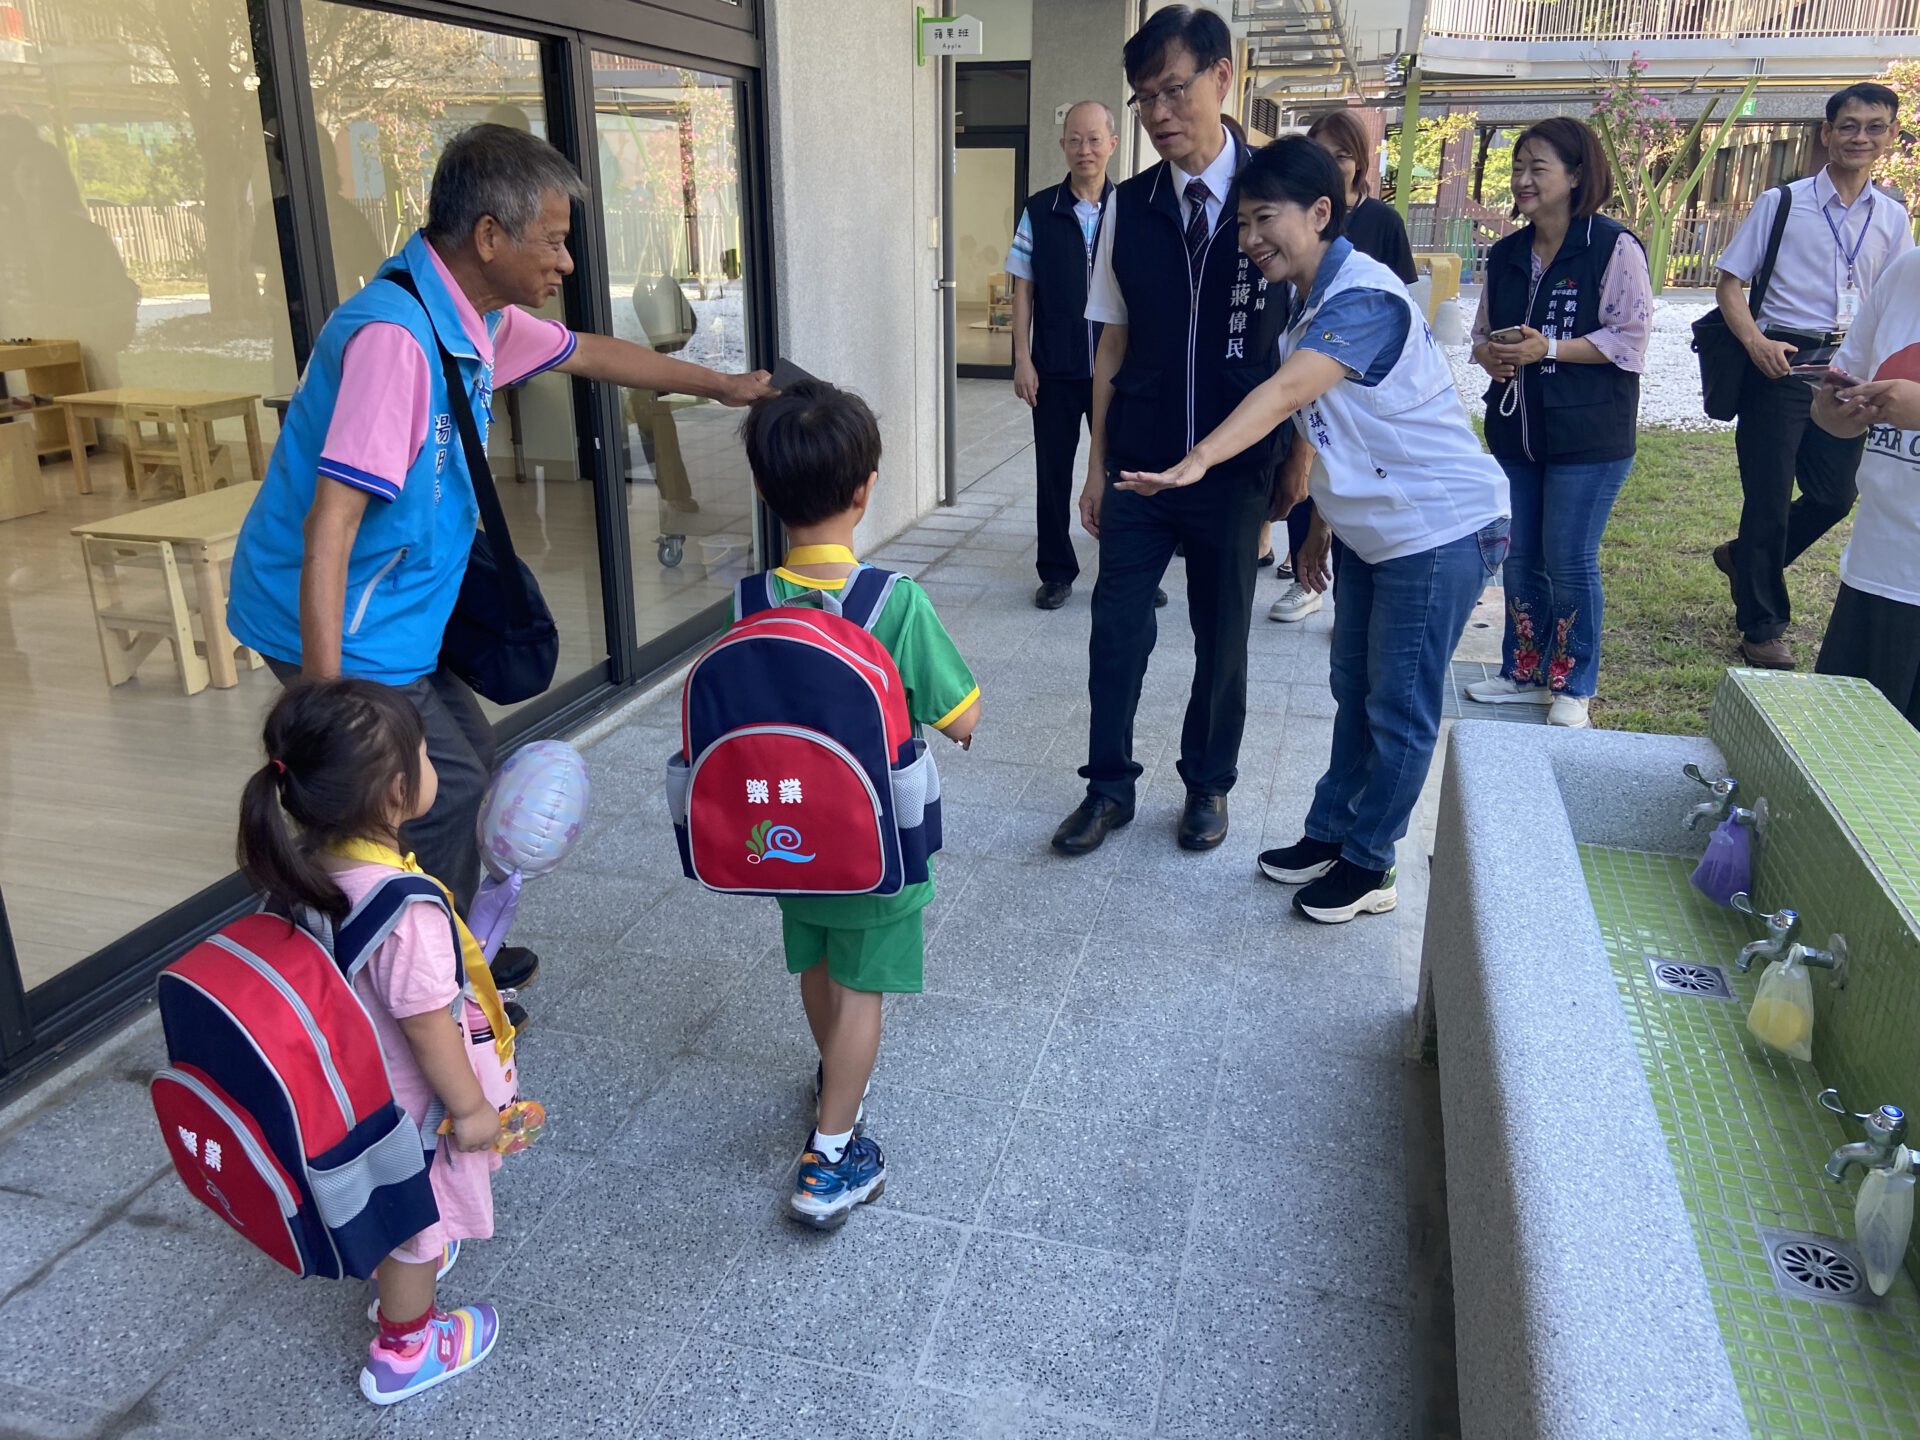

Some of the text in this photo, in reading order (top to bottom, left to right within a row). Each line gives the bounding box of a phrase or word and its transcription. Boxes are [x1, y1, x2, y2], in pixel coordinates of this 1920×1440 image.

[934, 28, 969, 40] 蘋果班
[942, 43, 962, 51] Apple
[1253, 277, 1269, 312] 育局
[745, 778, 804, 805] 樂業
